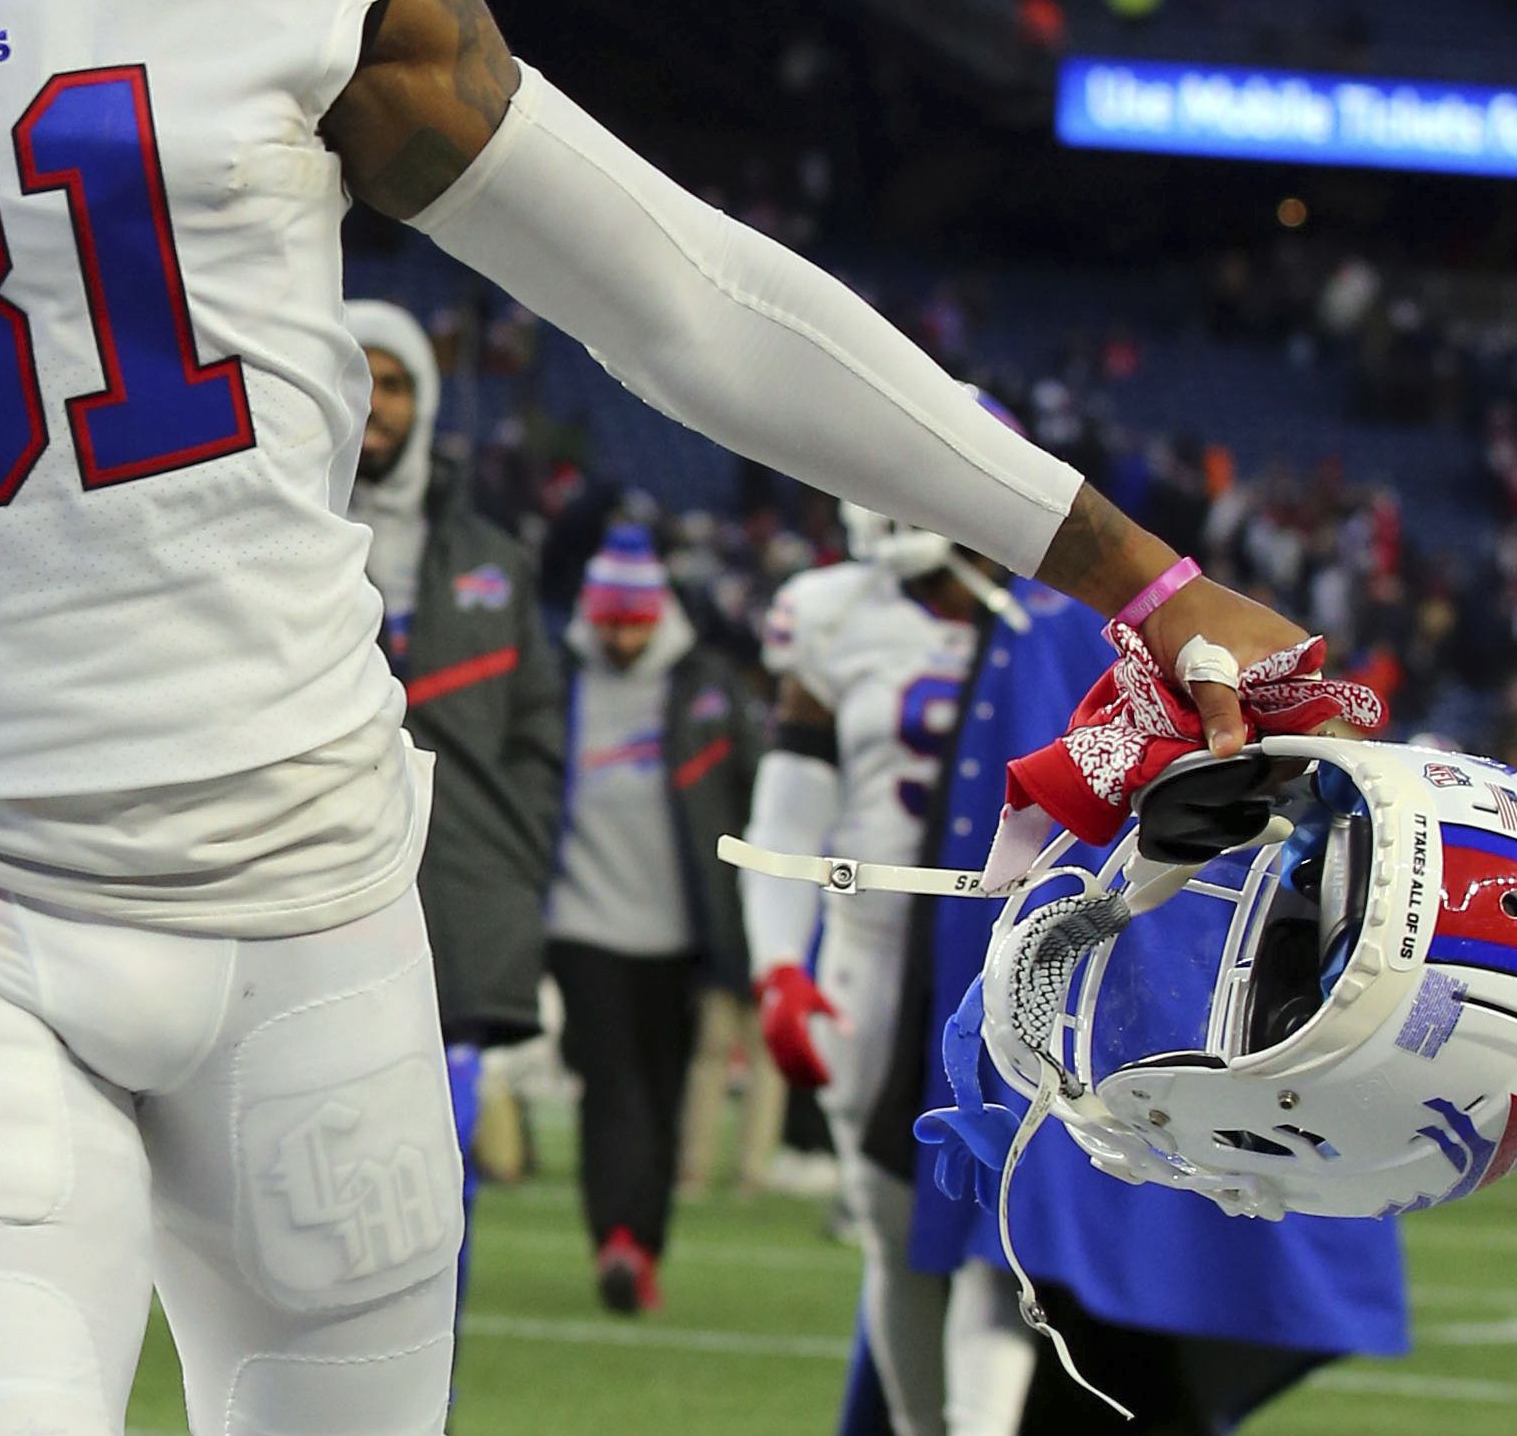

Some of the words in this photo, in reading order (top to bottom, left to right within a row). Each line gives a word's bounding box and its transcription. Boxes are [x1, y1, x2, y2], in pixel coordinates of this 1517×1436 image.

[1414, 814, 1427, 828] IT
[1412, 831, 1427, 876] TAKES
[1408, 878, 1424, 908] ALL
[1405, 913, 1419, 934] OF
[1400, 937, 1416, 959] US
